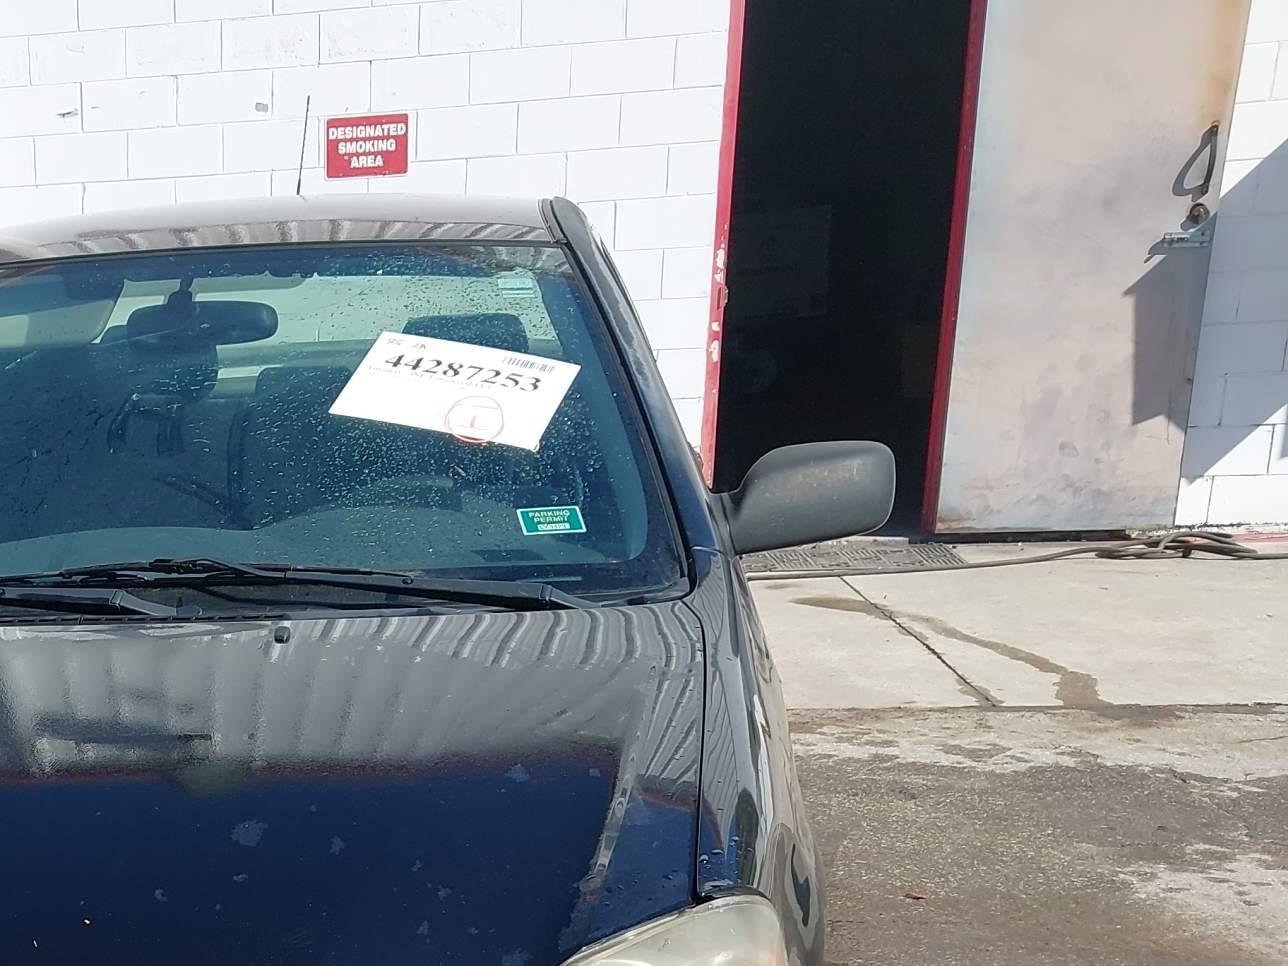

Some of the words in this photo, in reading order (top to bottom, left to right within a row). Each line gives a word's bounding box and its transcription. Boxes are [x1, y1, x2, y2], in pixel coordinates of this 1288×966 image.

[328, 123, 406, 140] DESIGNATED
[338, 138, 396, 154] SMOKING
[350, 155, 384, 168] AREA
[385, 354, 542, 392] 44287253
[528, 509, 571, 518] PARKING
[533, 515, 569, 523] PERMIT
